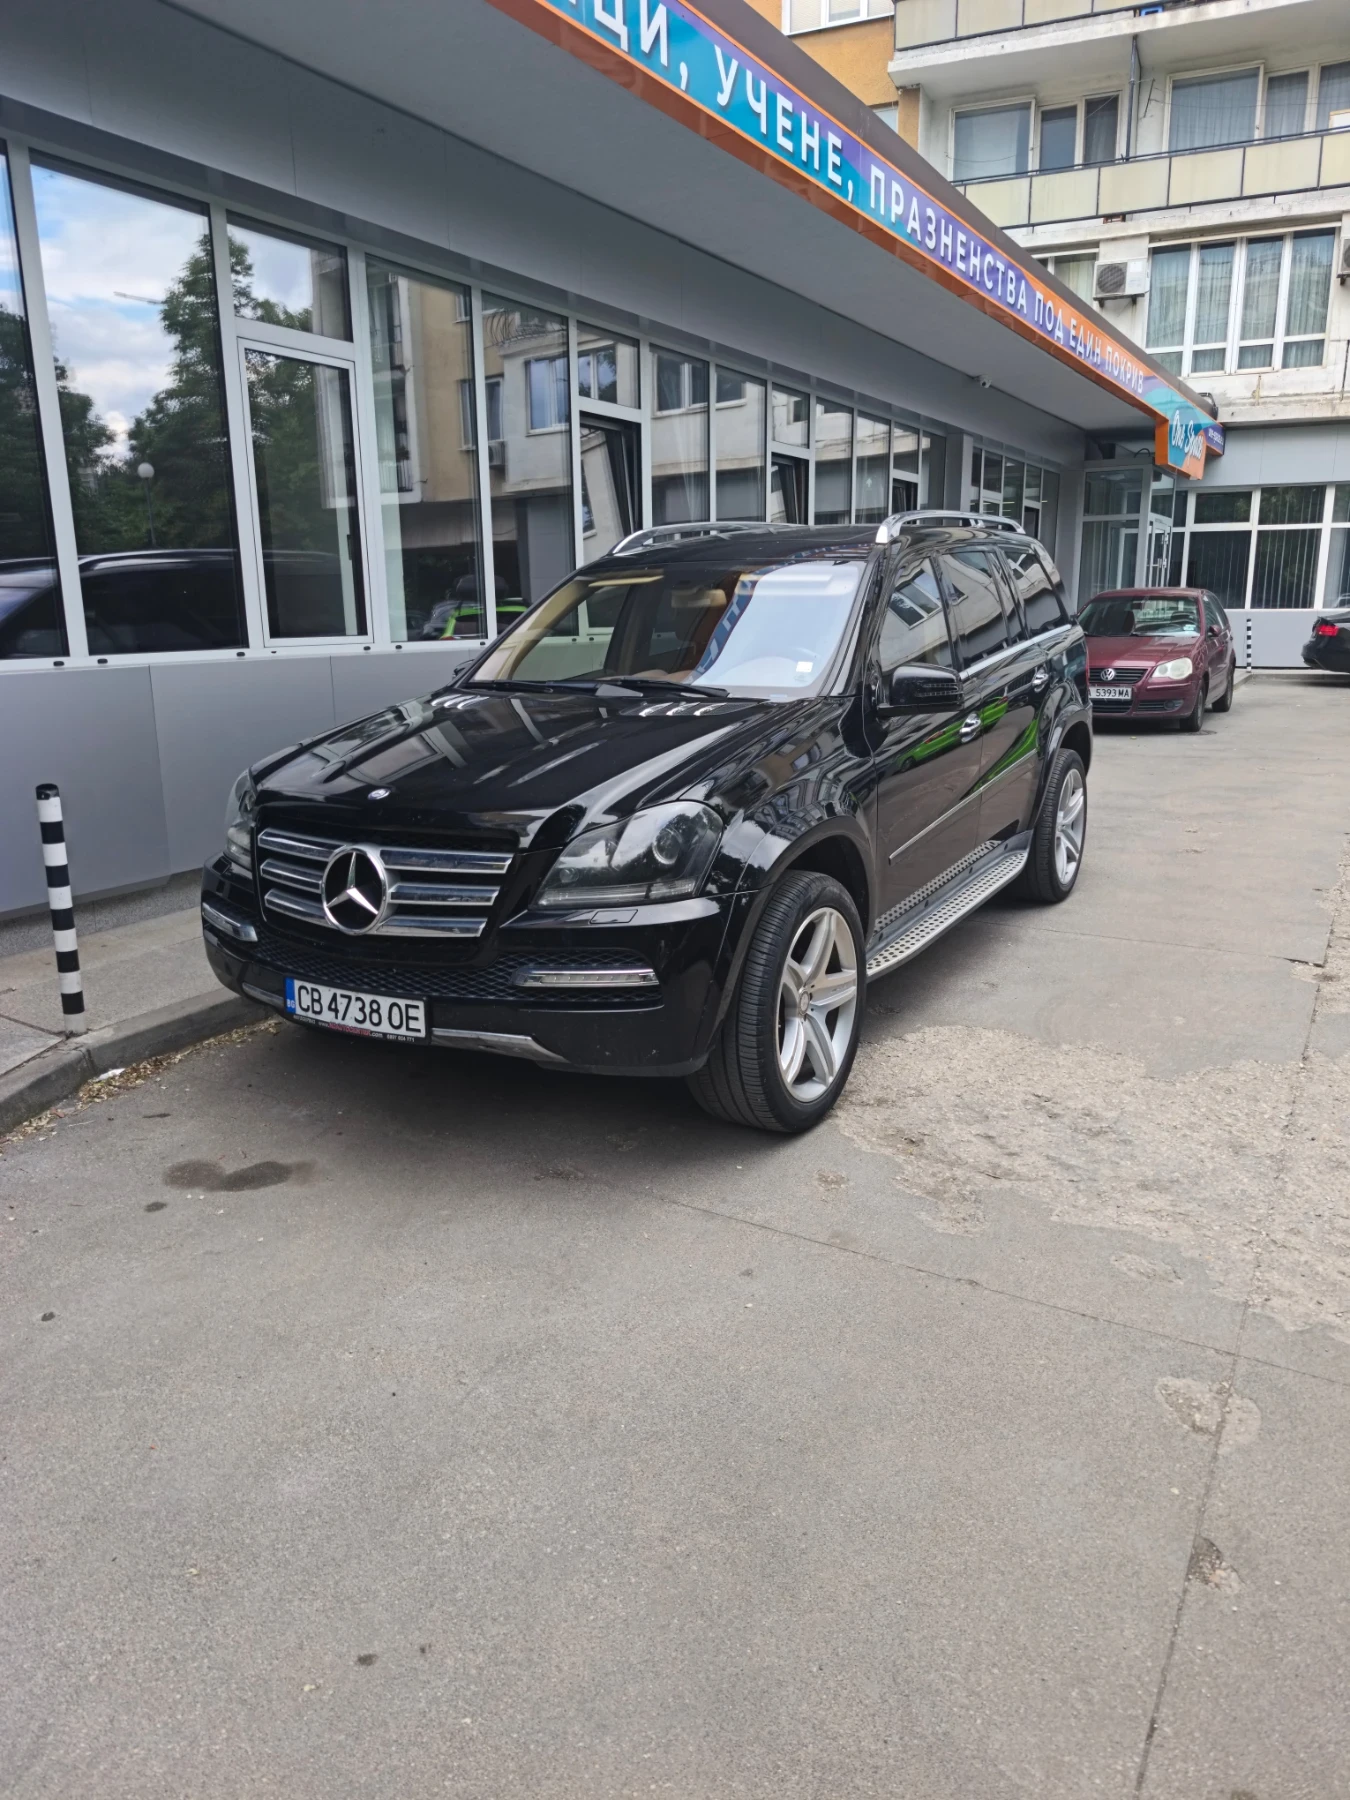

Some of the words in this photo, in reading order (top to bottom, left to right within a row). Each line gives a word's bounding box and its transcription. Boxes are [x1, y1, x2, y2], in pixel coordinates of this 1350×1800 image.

[569, 0, 689, 92] ЦИ,
[713, 44, 854, 203] УЧЕНЕ,
[869, 163, 1028, 315] ПРАЗНЕНСТВА
[1034, 291, 1065, 346] ПОД
[1069, 318, 1102, 366] ЕДИН
[1105, 345, 1145, 394] ПОКРИВ
[1095, 688, 1117, 698] 5393
[286, 998, 296, 1009] BG
[327, 991, 383, 1027] 4738
[387, 1001, 422, 1033] OE
